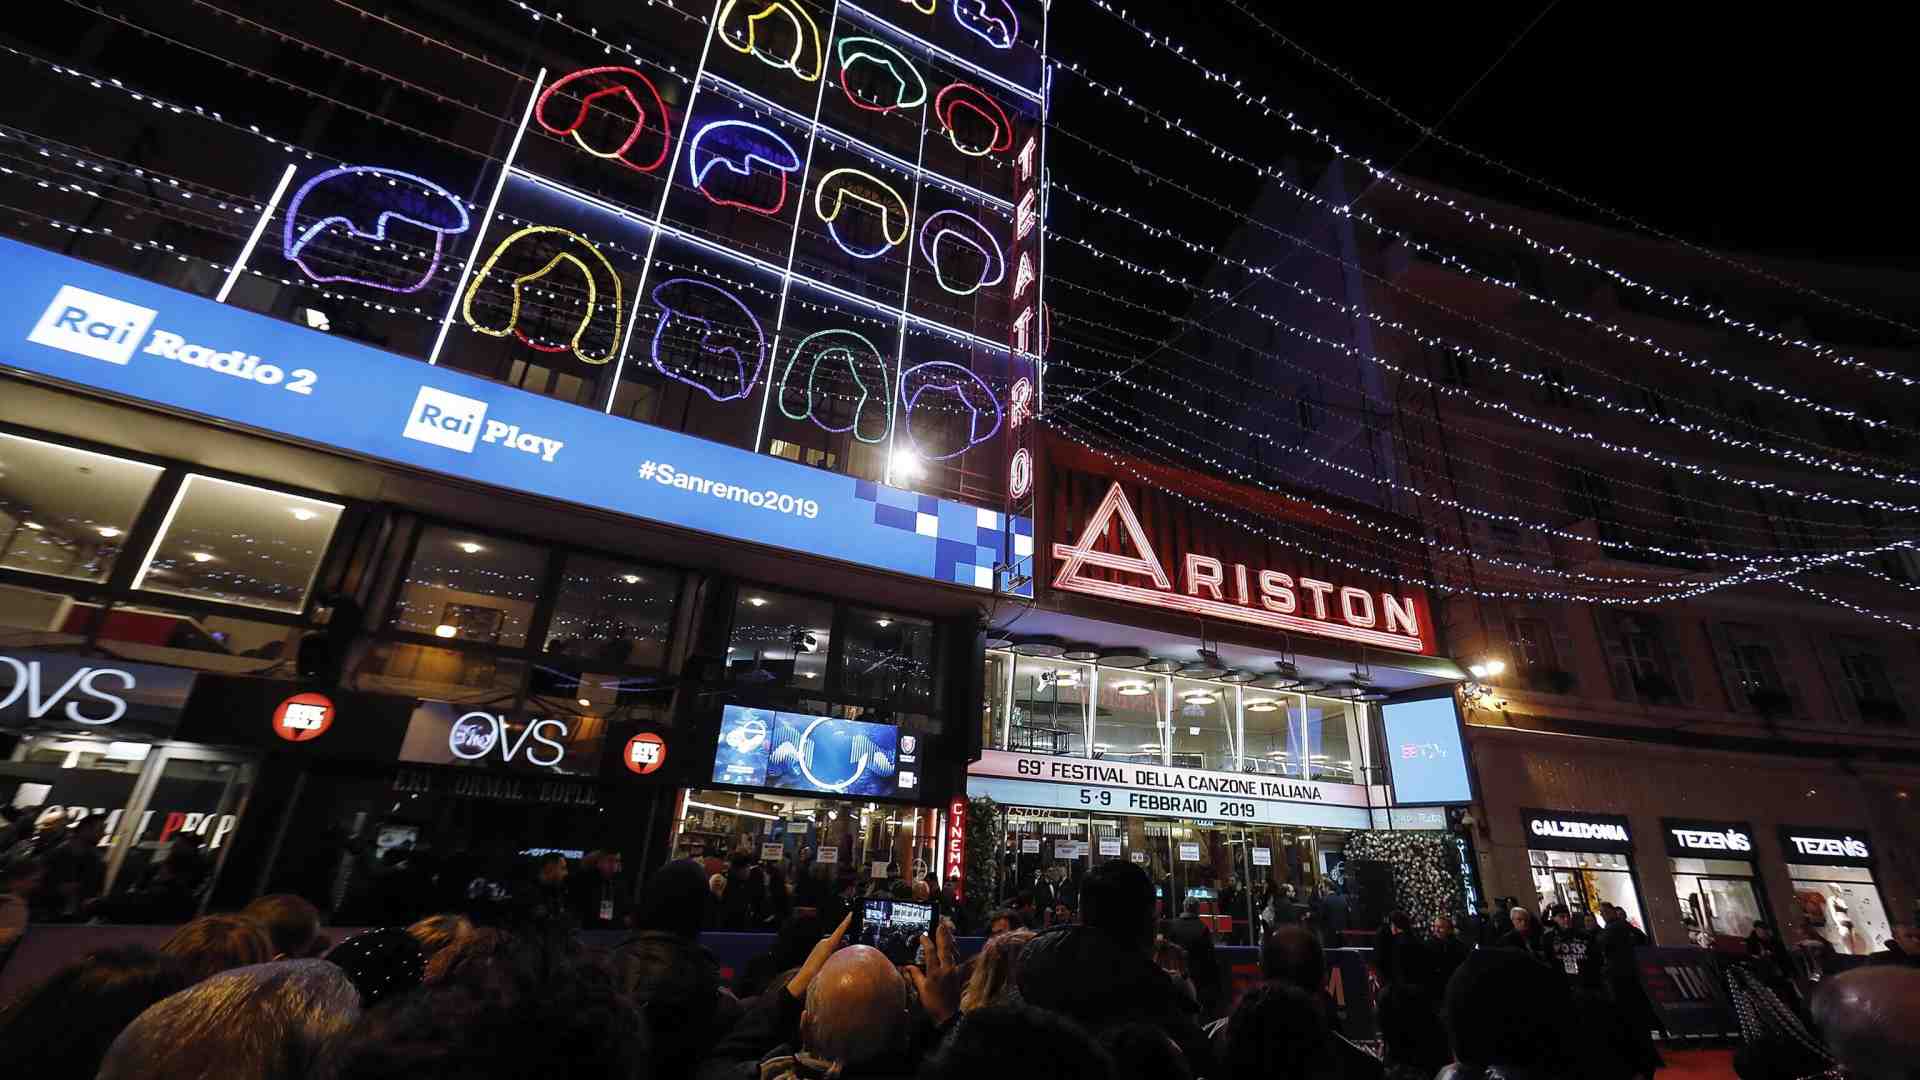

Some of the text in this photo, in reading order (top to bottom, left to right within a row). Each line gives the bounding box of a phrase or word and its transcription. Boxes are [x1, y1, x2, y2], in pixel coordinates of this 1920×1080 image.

[1010, 136, 1036, 500] TEATRO
[54, 305, 318, 395] Rai Radio 2
[418, 403, 564, 462] Rai Play
[638, 460, 820, 519] #Sanremo2019
[1052, 480, 1420, 637] ARISTON
[449, 711, 568, 766] OVS
[1051, 762, 1128, 784] FESTIVAL
[1136, 770, 1185, 789] DELLA
[1188, 775, 1257, 796] CANZONE
[1260, 782, 1322, 801] ITALIANA
[1129, 793, 1207, 814] FEBBRAIO
[1219, 801, 1255, 818] 2019
[949, 802, 964, 879] CINEMA
